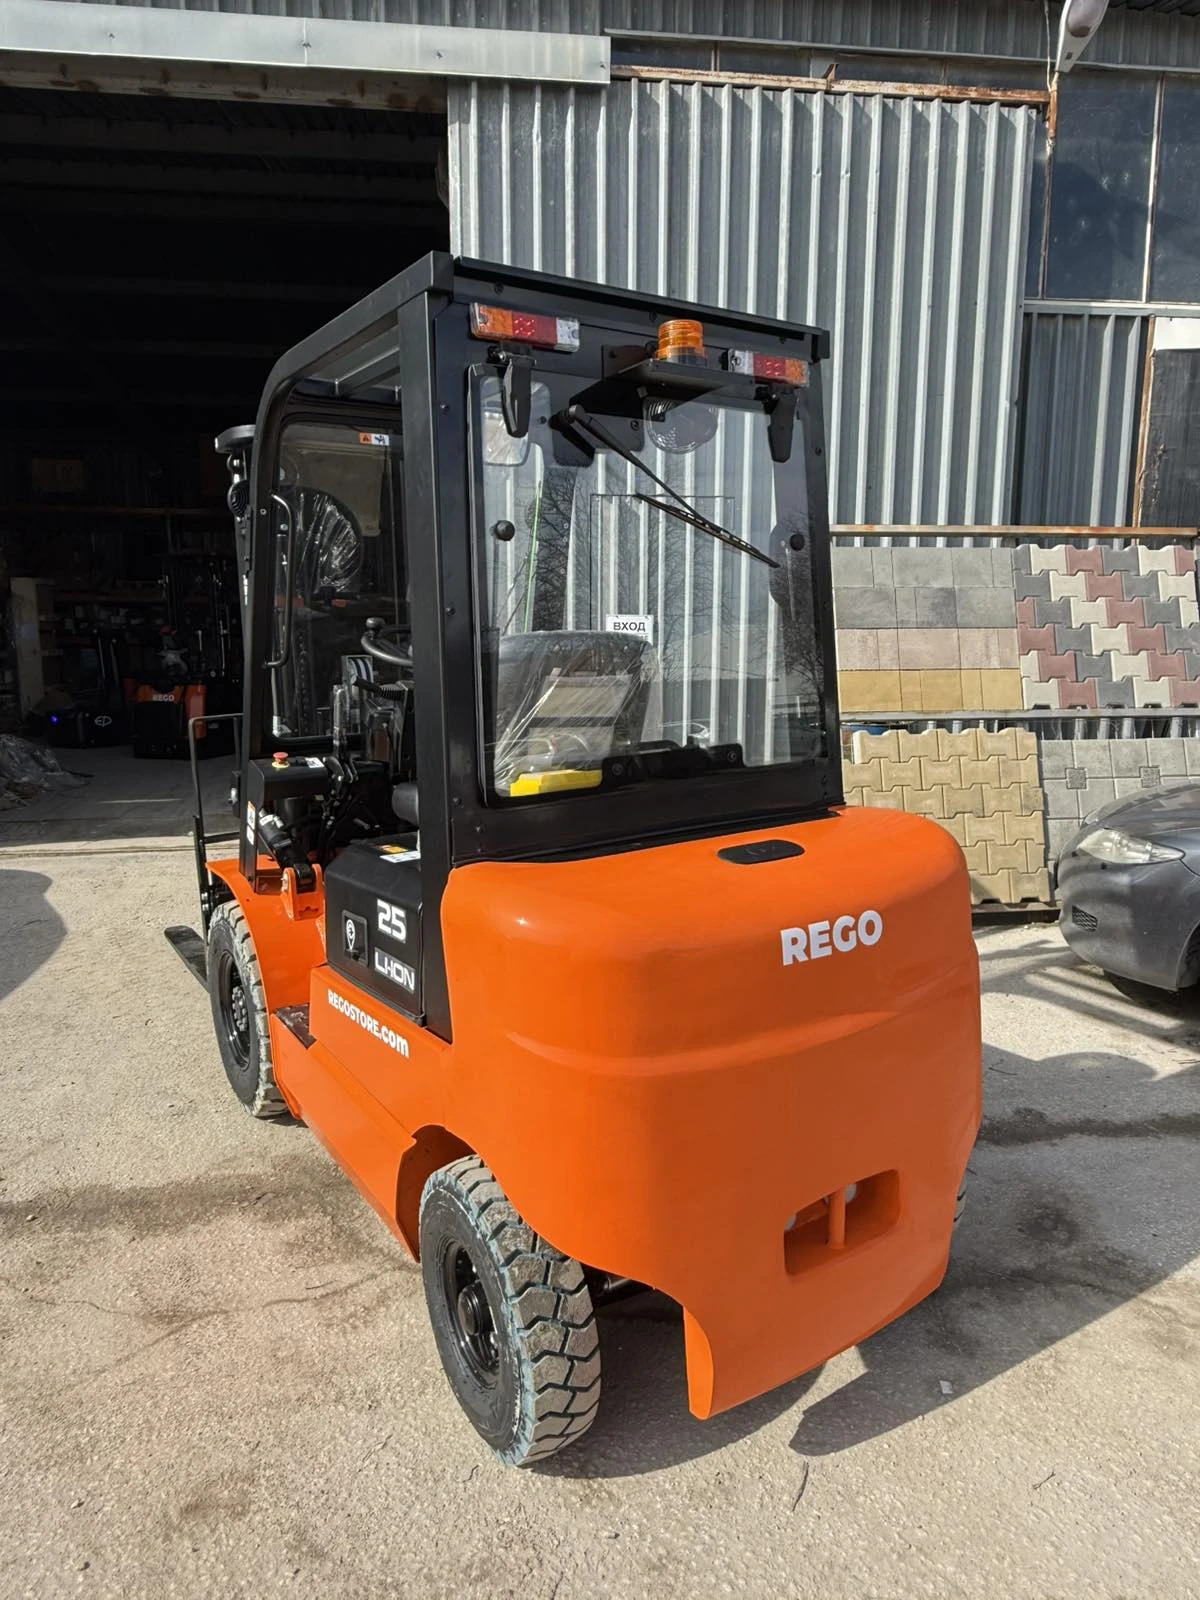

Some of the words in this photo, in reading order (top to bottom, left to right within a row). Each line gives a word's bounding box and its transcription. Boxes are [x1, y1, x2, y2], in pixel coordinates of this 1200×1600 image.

[613, 622, 646, 632] ВХОД
[377, 898, 406, 941] 25
[780, 909, 883, 966] REGO
[328, 988, 409, 1059] REGOSTORE.com
